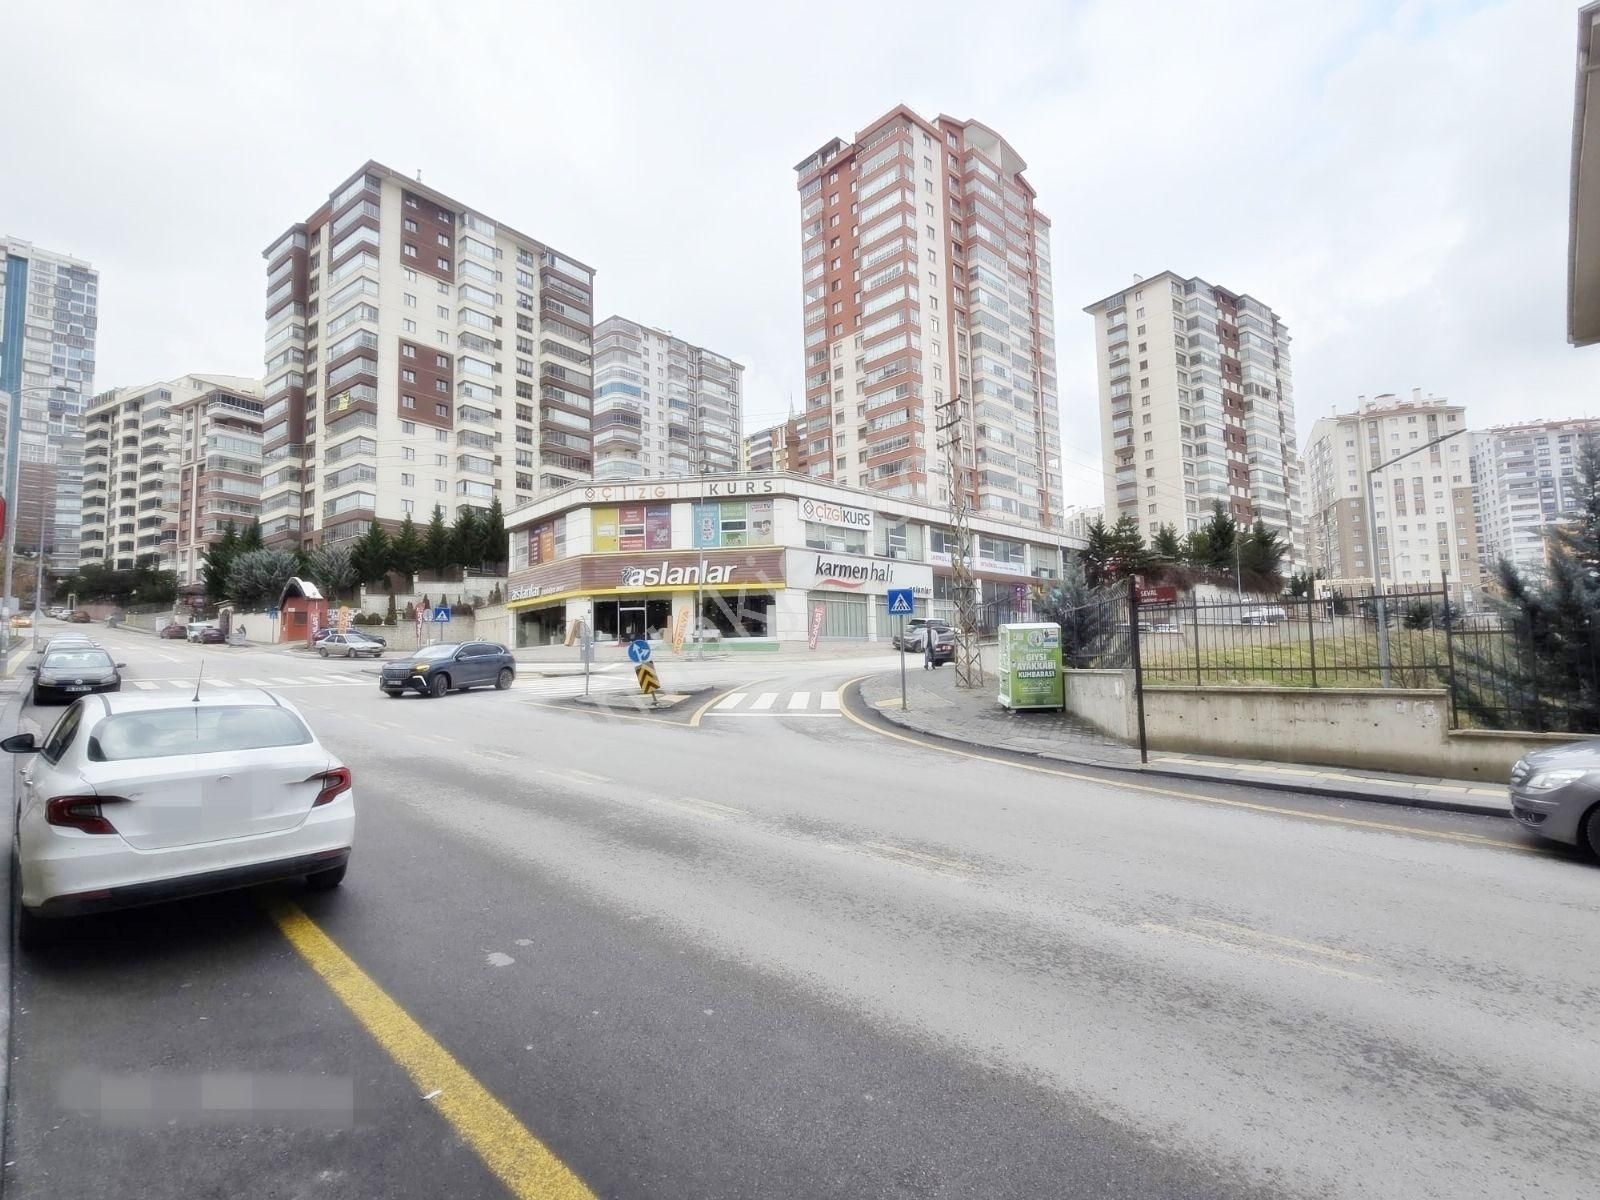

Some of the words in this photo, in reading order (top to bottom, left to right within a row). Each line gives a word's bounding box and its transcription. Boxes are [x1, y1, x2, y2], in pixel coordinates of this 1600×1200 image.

[709, 481, 773, 495] KURS
[628, 560, 737, 586] aslanlar
[814, 555, 869, 579] karmen
